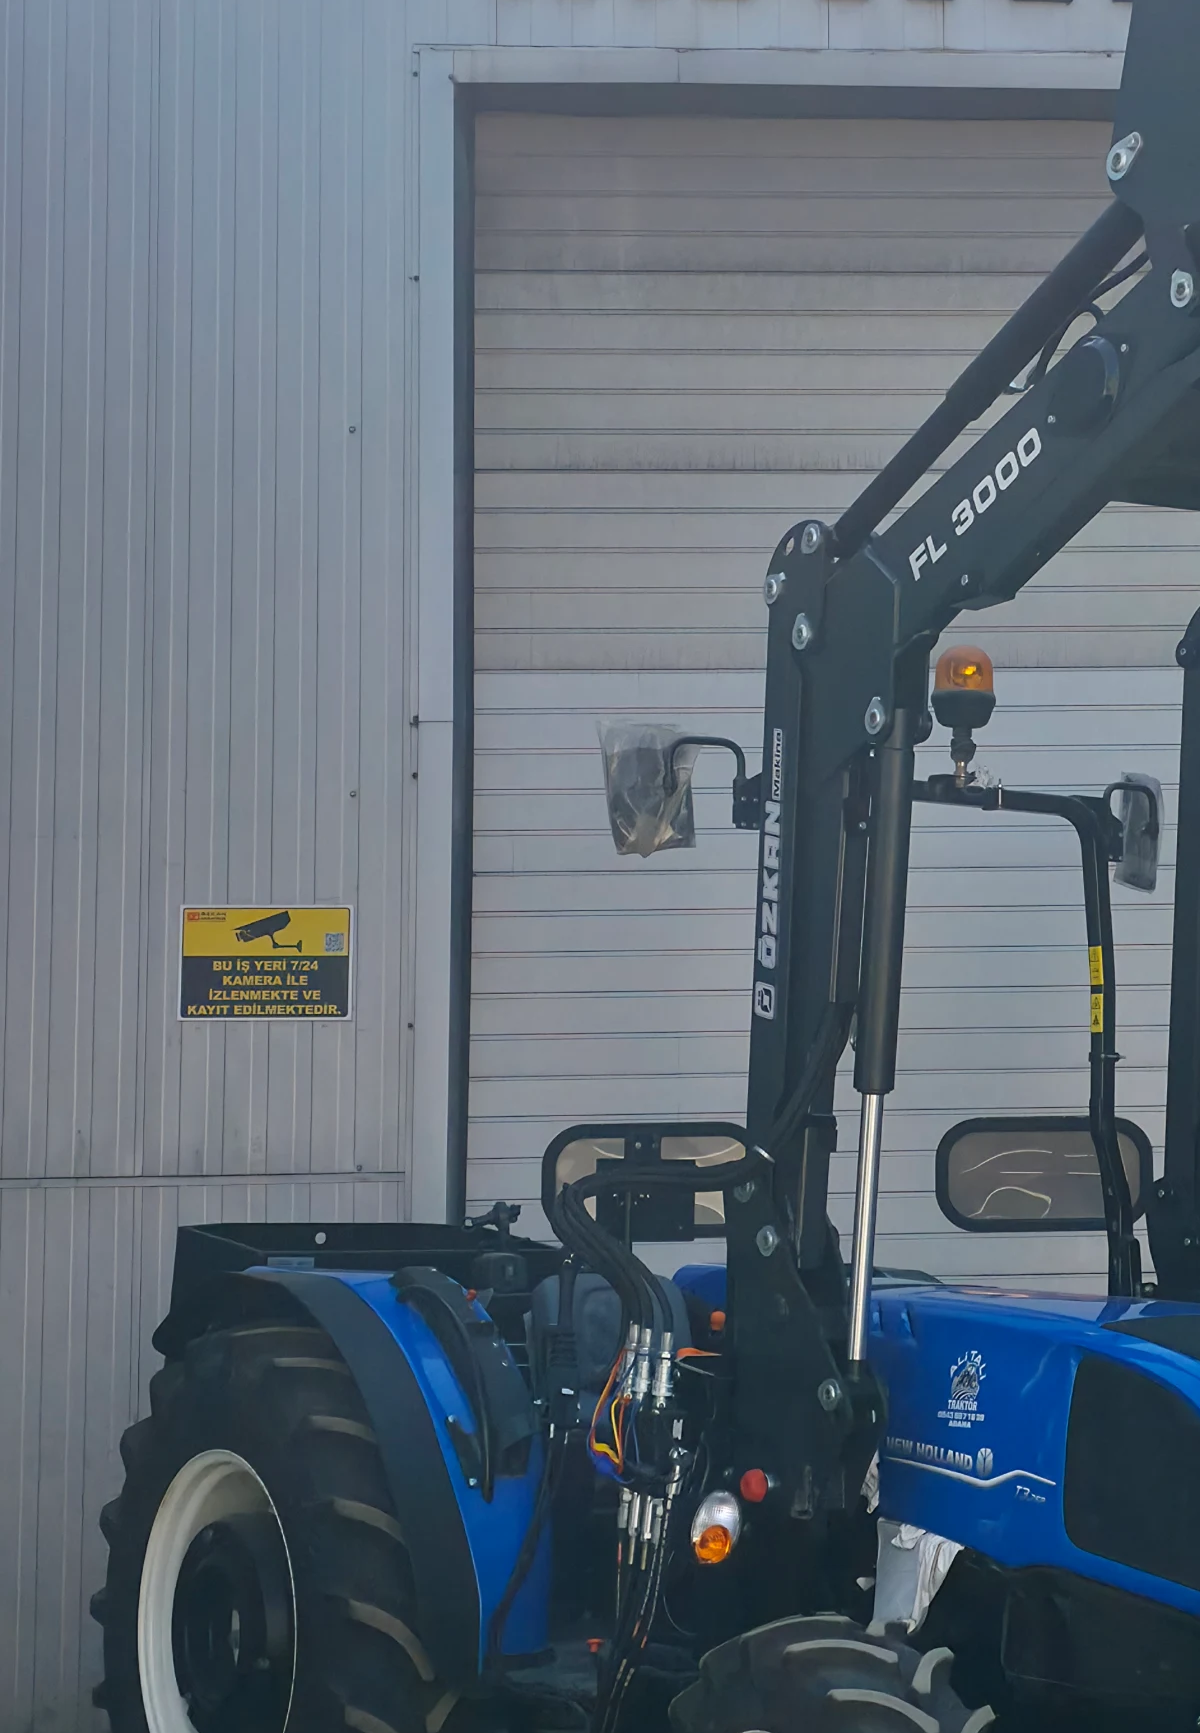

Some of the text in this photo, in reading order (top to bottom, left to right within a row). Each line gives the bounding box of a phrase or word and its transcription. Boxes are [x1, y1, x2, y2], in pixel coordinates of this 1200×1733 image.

[908, 427, 1042, 582] FL 3000
[757, 801, 780, 969] ÖZKAN
[772, 731, 782, 798] Makina
[212, 959, 319, 972] BU İŞ YERİ 7/24
[222, 973, 308, 986] KAMERA İLE
[208, 989, 321, 1001] İZLENMEKTE VE
[187, 1003, 341, 1016] KAYIT EDİLMEKTEDİR.
[948, 1398, 978, 1411] TRAKTÖR
[916, 1442, 973, 1470] HOLLAND
